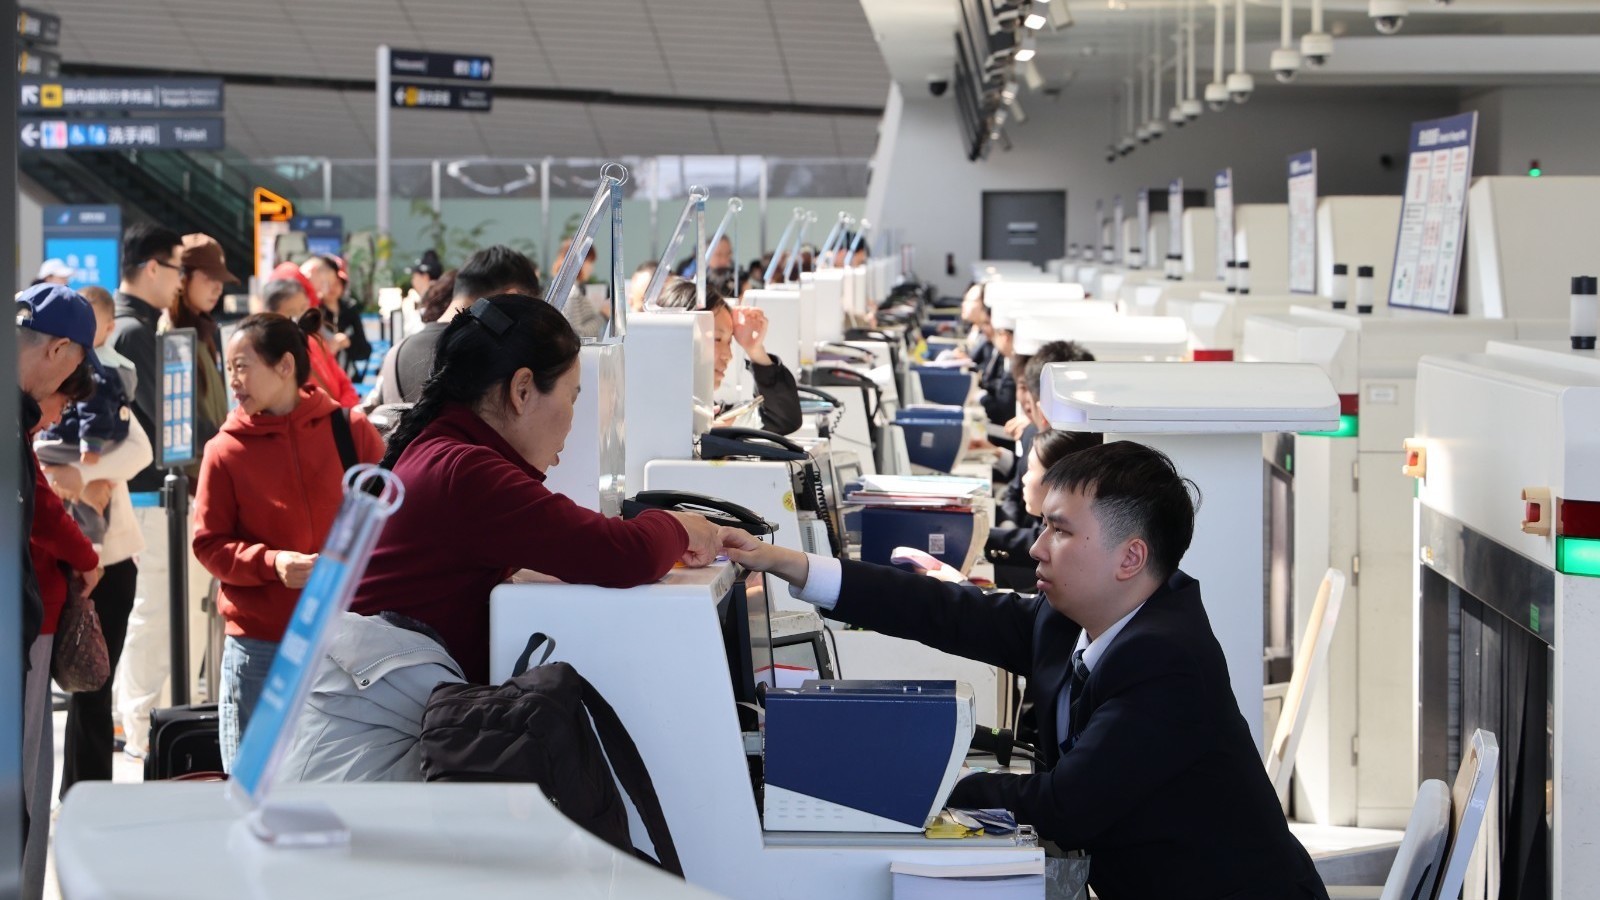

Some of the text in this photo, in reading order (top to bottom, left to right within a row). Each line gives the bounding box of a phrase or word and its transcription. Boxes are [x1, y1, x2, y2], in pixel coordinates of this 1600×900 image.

[108, 125, 208, 144] 洗手间 Toilet
